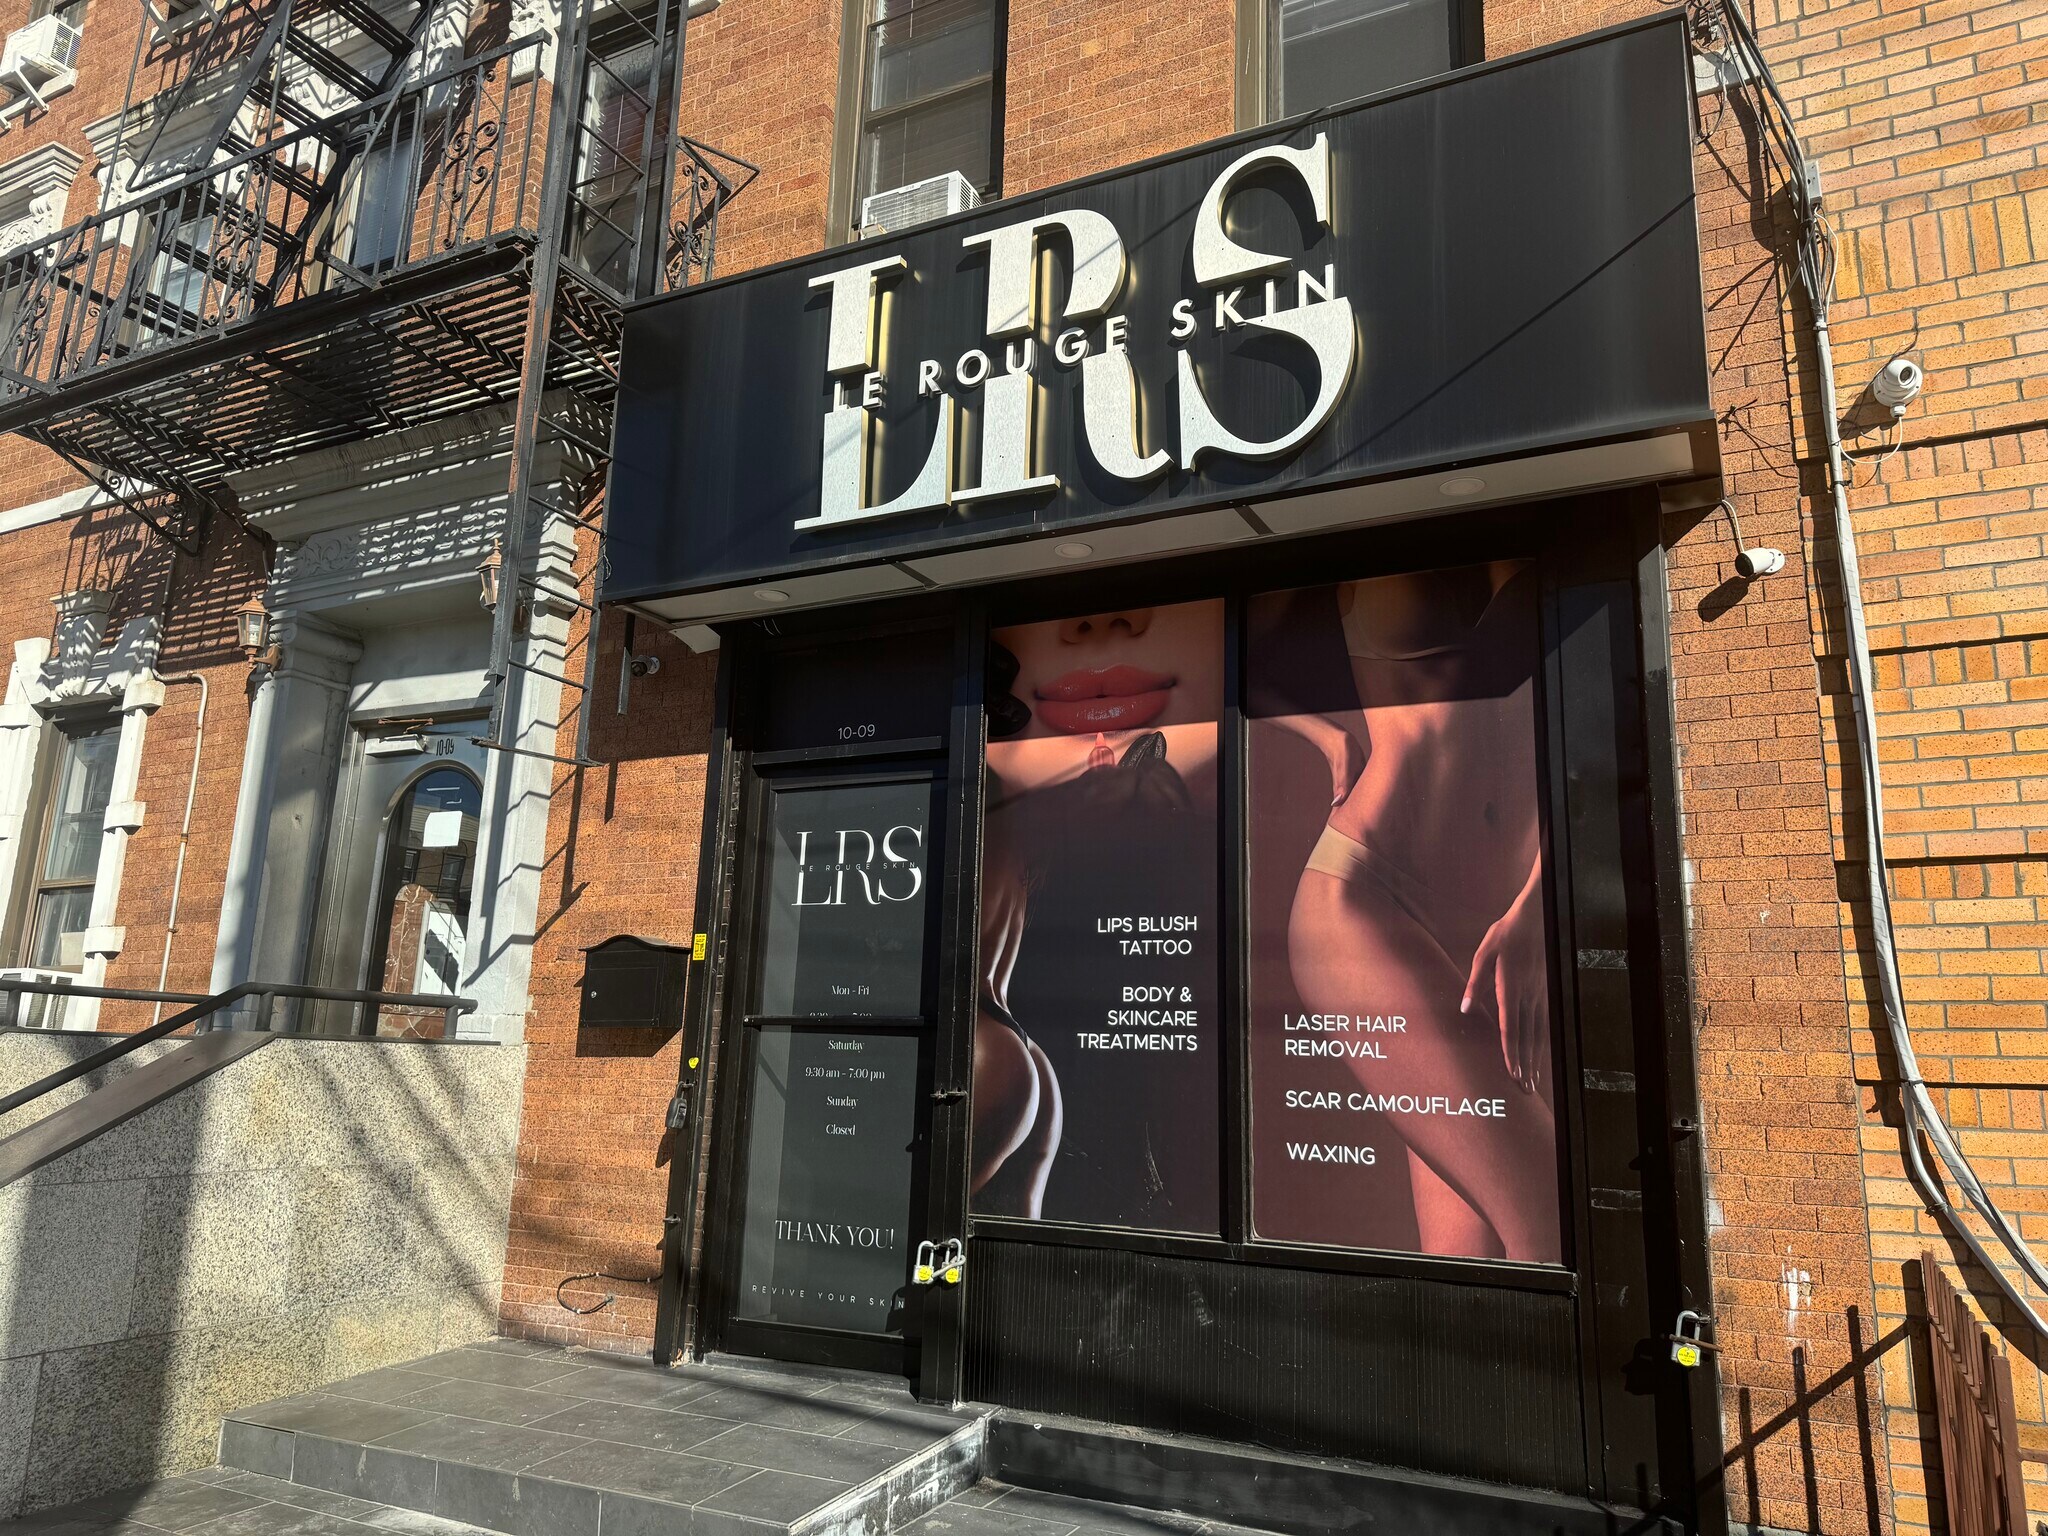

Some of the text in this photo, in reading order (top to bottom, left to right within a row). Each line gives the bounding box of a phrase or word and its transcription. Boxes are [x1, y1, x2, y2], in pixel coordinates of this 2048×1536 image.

[794, 132, 1357, 530] LRS
[833, 263, 1336, 410] LE ROUGE SKIN
[837, 723, 876, 740] 10-09
[436, 738, 455, 756] 10-09
[791, 825, 923, 907] LRS
[799, 861, 915, 873] LE ROUGE SKIN
[1097, 915, 1198, 934] LIPS BLUSH
[1119, 939, 1193, 956] TATTOO
[832, 985, 850, 995] Mon
[858, 985, 870, 996] Fri
[1122, 986, 1193, 1003] BODY &
[1107, 1010, 1198, 1027] SKINCARE
[1283, 1013, 1406, 1033] LASER HAIR
[828, 1040, 864, 1053] Saturday
[1077, 1032, 1198, 1051] TREATMENTS
[1284, 1039, 1388, 1059] REMOVAL
[826, 1070, 840, 1078] am
[849, 1067, 868, 1079] 7:00
[870, 1071, 885, 1081] pm
[826, 1096, 859, 1109] Sunday
[1285, 1090, 1506, 1117] SCAR CAMOUFLAGE
[825, 1124, 856, 1136] Closed
[1287, 1142, 1376, 1165] WAXING
[775, 1220, 894, 1249] THANK YOU!
[752, 1284, 904, 1309] REVIVE YOUR SKIN
